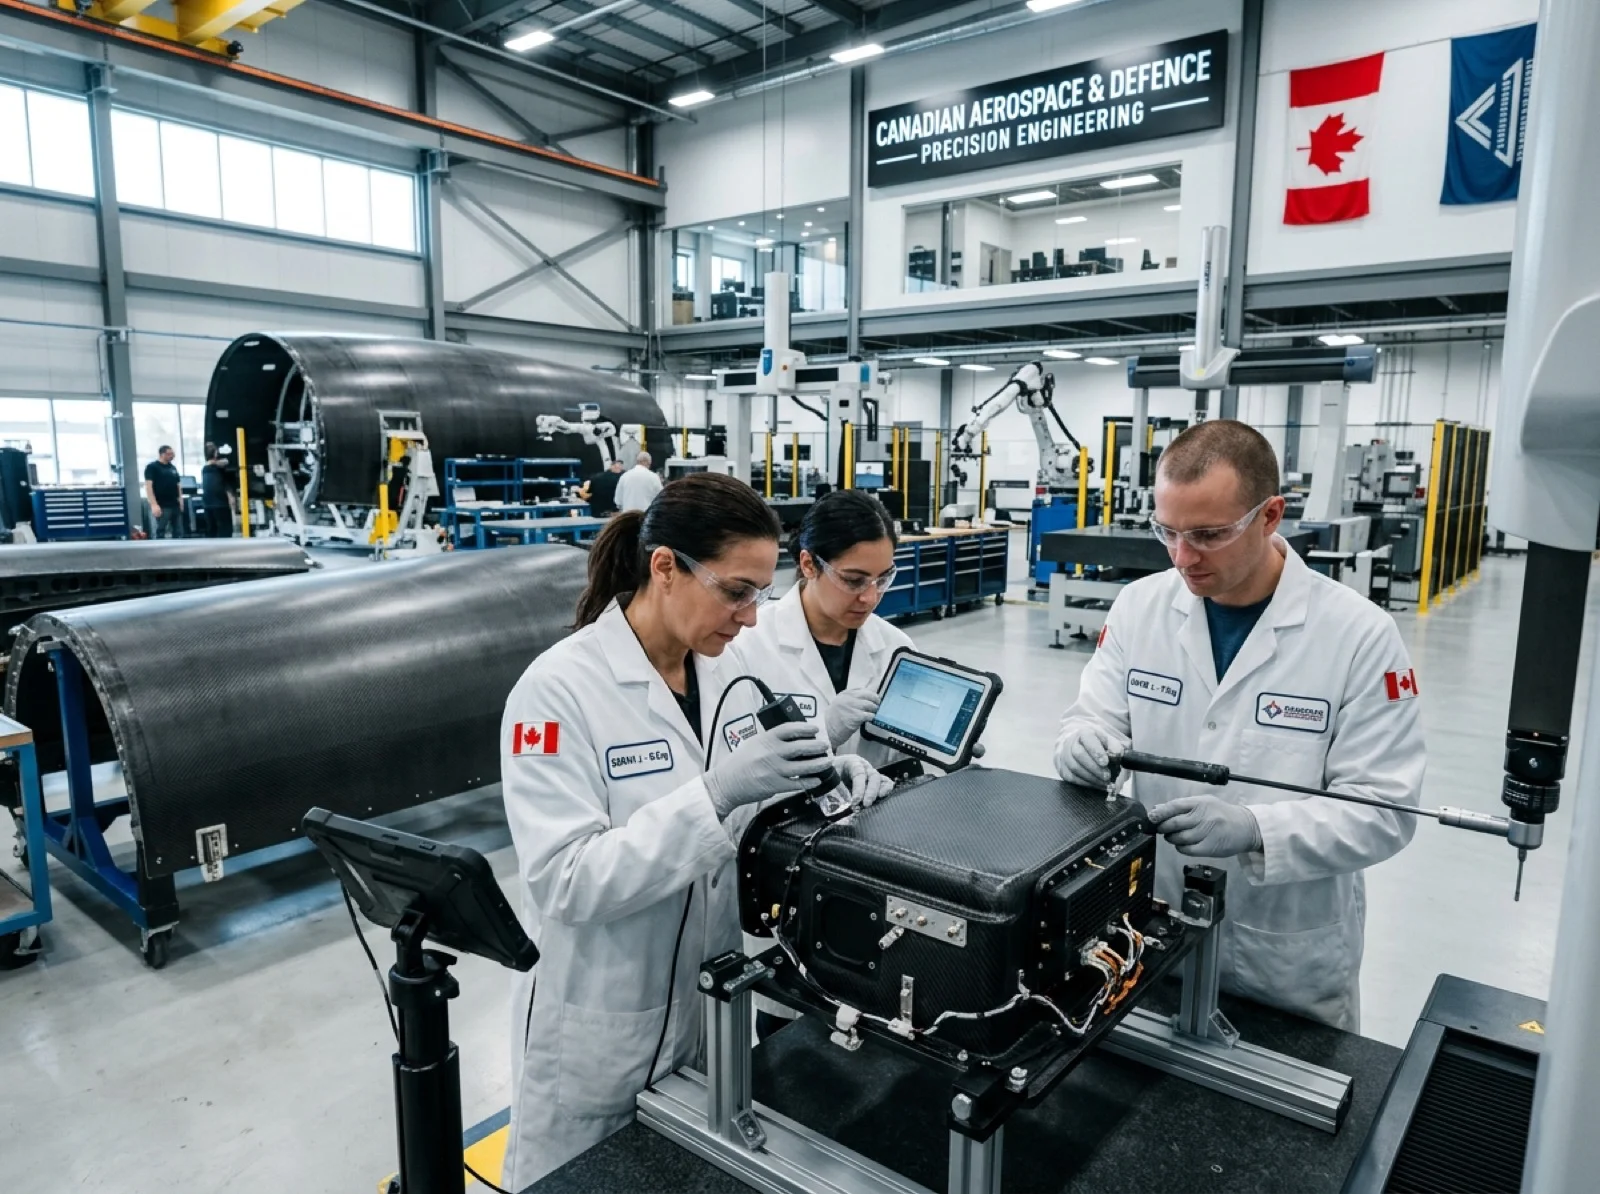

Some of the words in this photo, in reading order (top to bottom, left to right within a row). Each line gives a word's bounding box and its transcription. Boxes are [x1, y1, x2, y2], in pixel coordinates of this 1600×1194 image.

[875, 103, 966, 147] CANADIAN
[968, 77, 1085, 129] AEROSPACE
[1087, 73, 1105, 103] &
[1110, 49, 1212, 97] DEFENCE
[920, 126, 1011, 165] PRECISION
[1016, 101, 1145, 147] ENGINEERING
